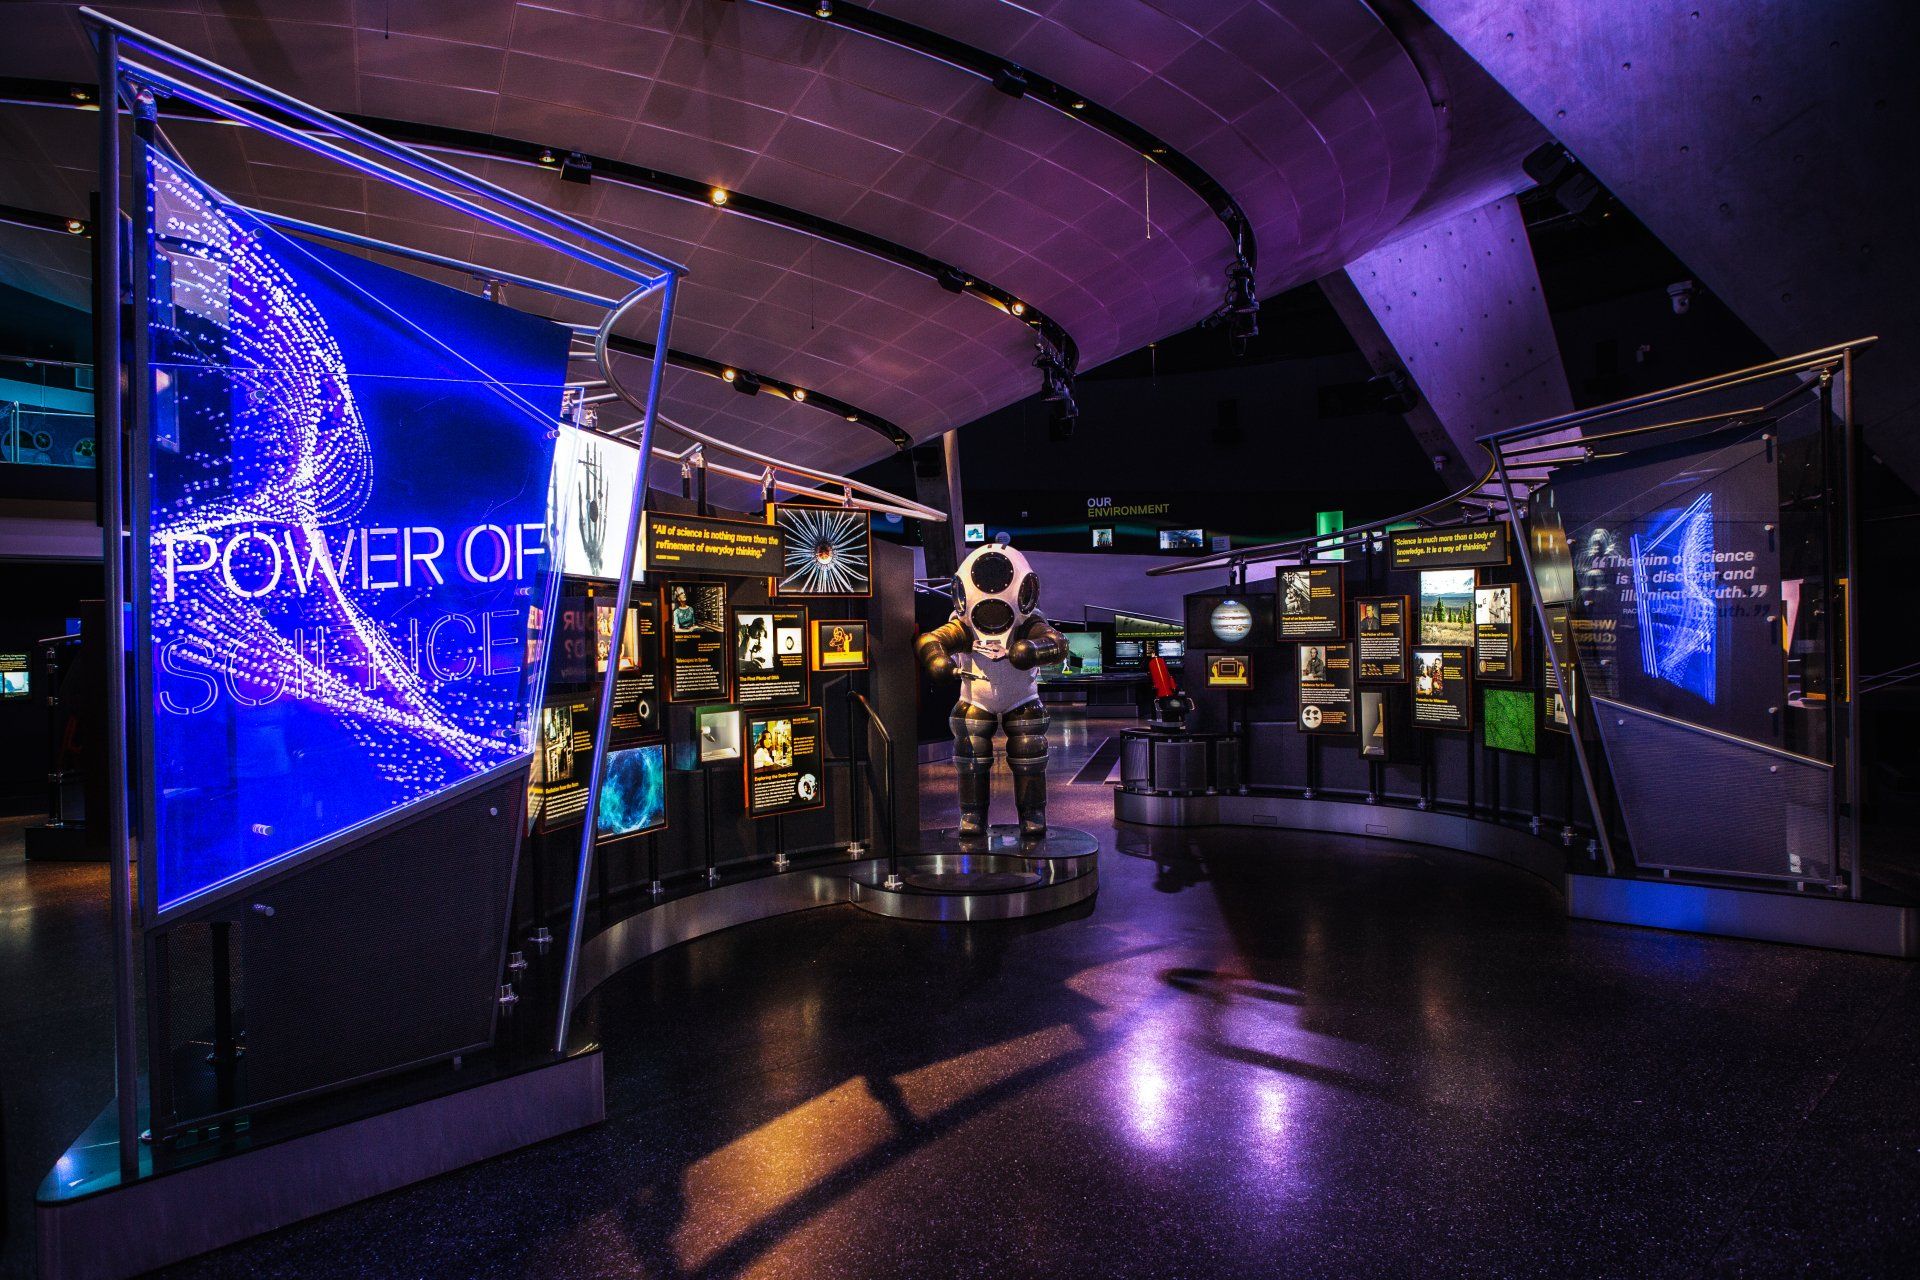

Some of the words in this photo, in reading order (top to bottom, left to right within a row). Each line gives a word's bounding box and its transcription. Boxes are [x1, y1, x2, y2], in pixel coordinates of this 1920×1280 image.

[1087, 497, 1112, 508] OUR
[1087, 503, 1170, 518] ENVIRONMENT
[667, 526, 676, 536] of
[676, 527, 702, 538] science
[703, 529, 710, 539] is
[710, 531, 735, 543] nothing
[736, 534, 753, 543] more
[753, 535, 768, 545] than
[768, 536, 779, 546] the
[1417, 536, 1422, 544] is
[1423, 535, 1438, 544] much
[1439, 535, 1453, 543] more
[1473, 531, 1489, 540] body
[1490, 530, 1497, 538] of
[655, 540, 696, 552] refinement
[696, 543, 705, 552] of
[705, 545, 735, 557] everyday
[1396, 547, 1425, 556] knowledge.
[1443, 545, 1454, 553] way
[1455, 544, 1462, 552] of
[165, 526, 445, 603] POWER
[465, 523, 547, 583] OF
[1615, 572, 1629, 585] is
[1652, 569, 1720, 584] discver
[1723, 566, 1756, 580] and
[159, 609, 521, 716] SCIENCE
